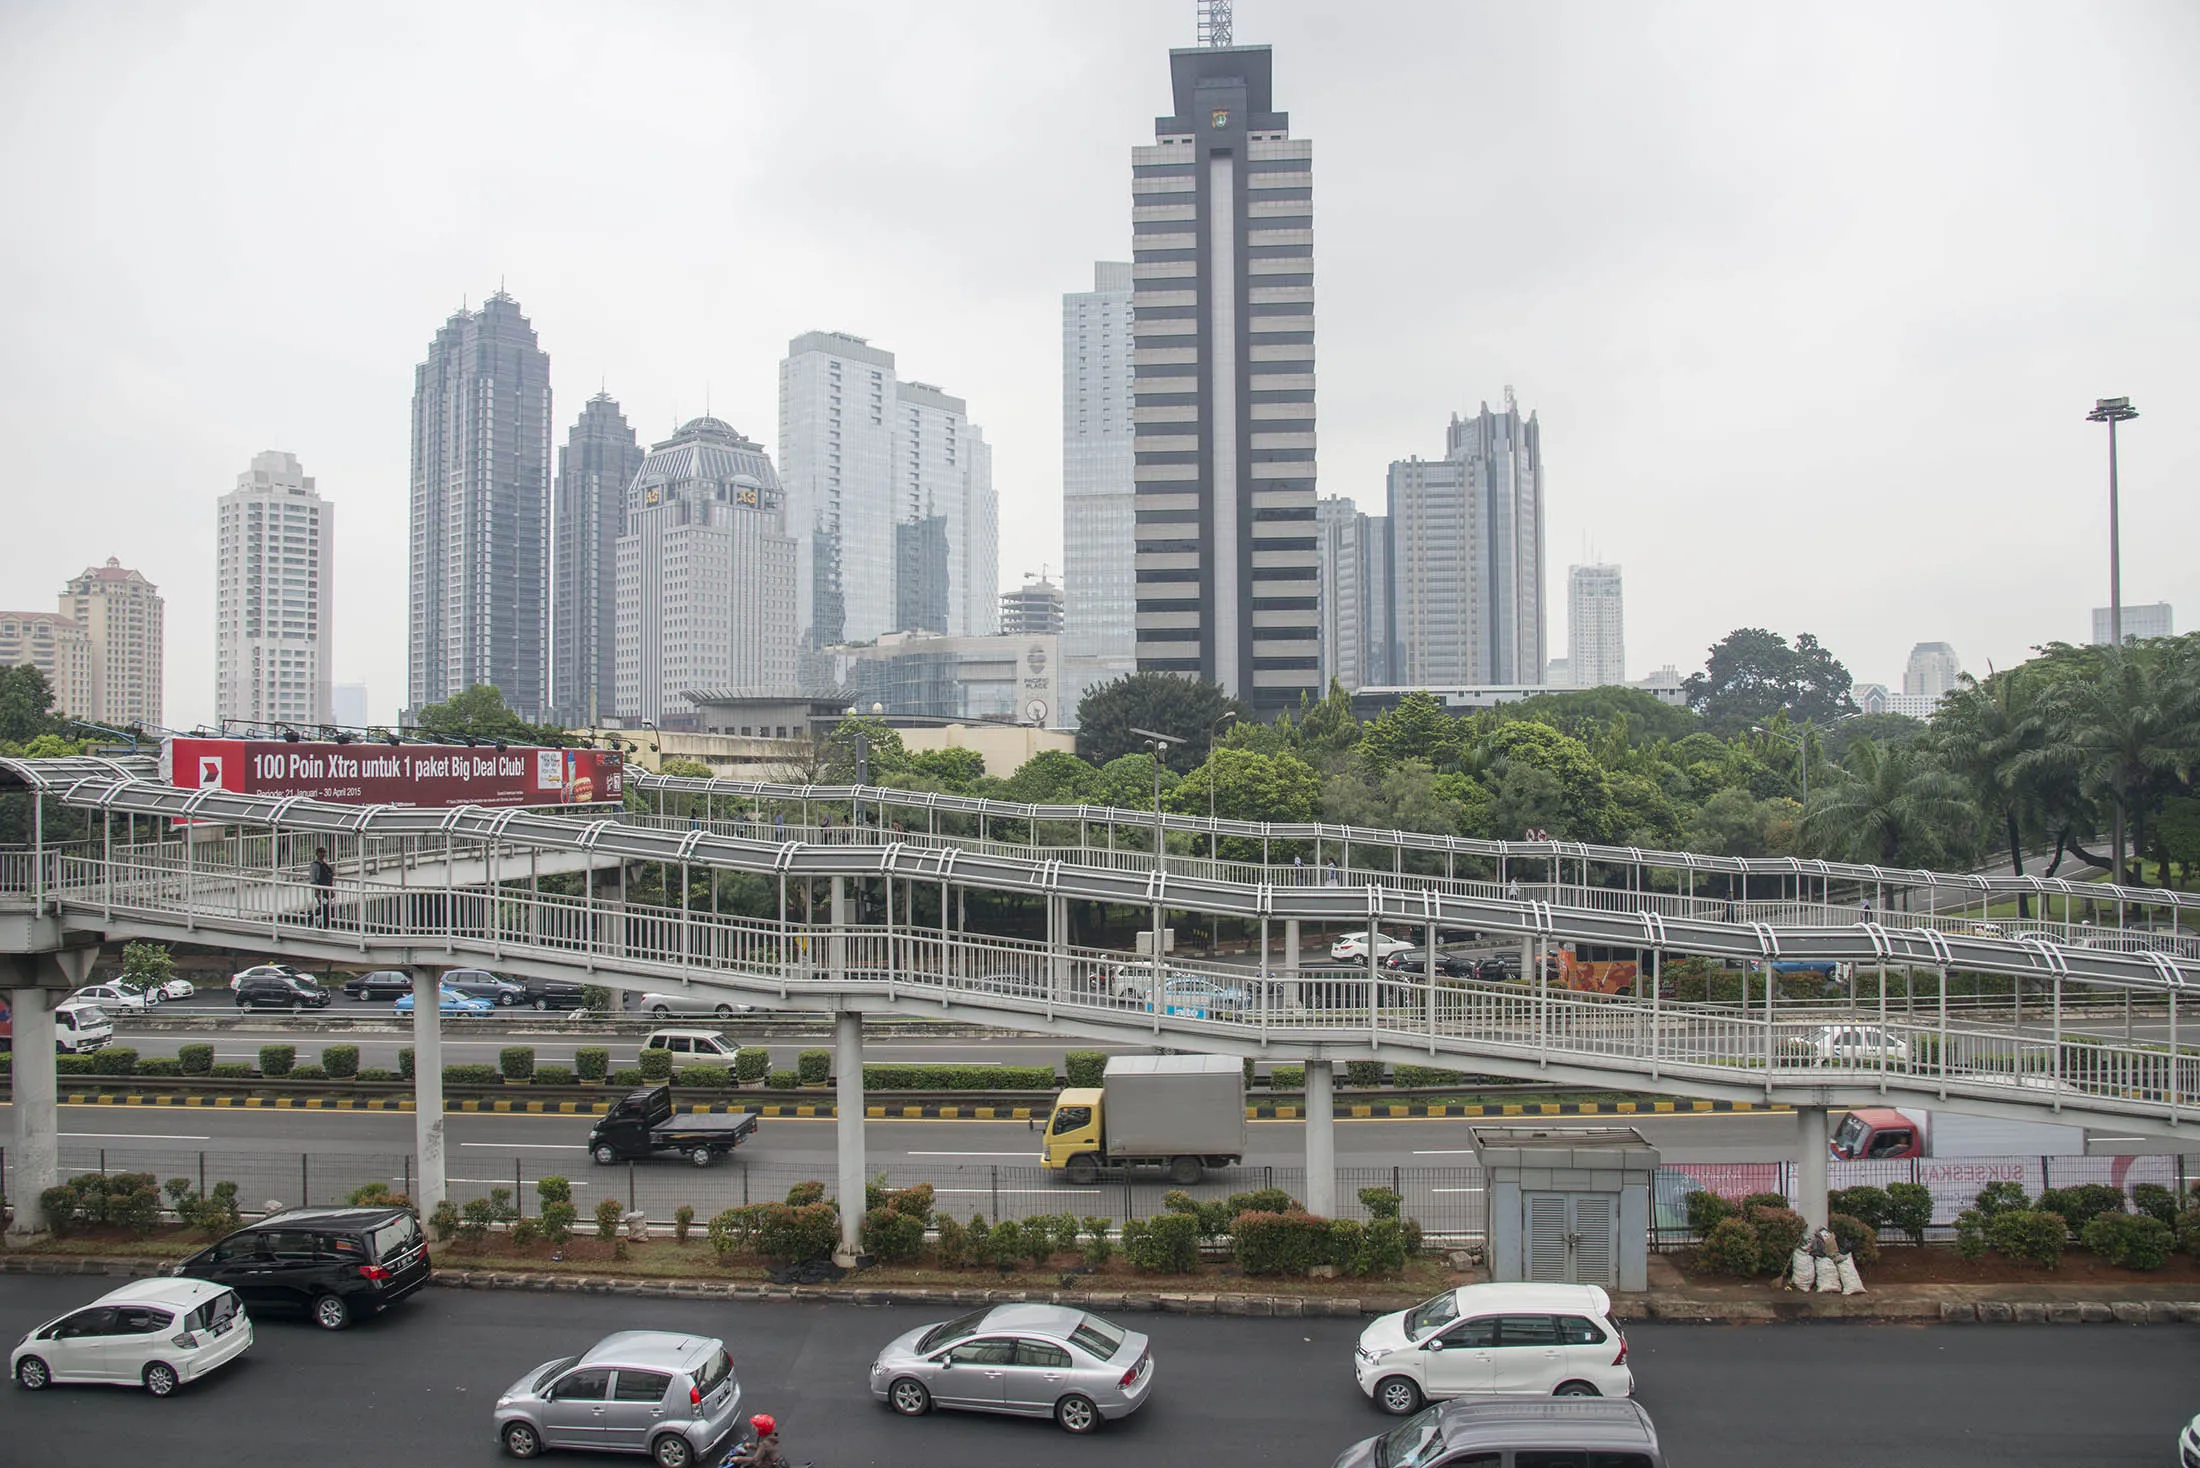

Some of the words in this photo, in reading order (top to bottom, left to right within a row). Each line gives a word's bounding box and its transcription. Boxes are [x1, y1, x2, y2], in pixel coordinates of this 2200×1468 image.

[254, 754, 285, 779] 100
[289, 754, 323, 778] Poin
[328, 755, 358, 778] Xtra
[362, 755, 400, 777] untuk
[404, 755, 410, 777] 1
[415, 756, 449, 782] paket
[452, 756, 470, 781] Big
[473, 757, 496, 777] Deal
[499, 757, 525, 776] Club!
[286, 789, 294, 797] 21
[324, 788, 332, 796] 30
[333, 787, 346, 797] April
[347, 787, 361, 796] 2015
